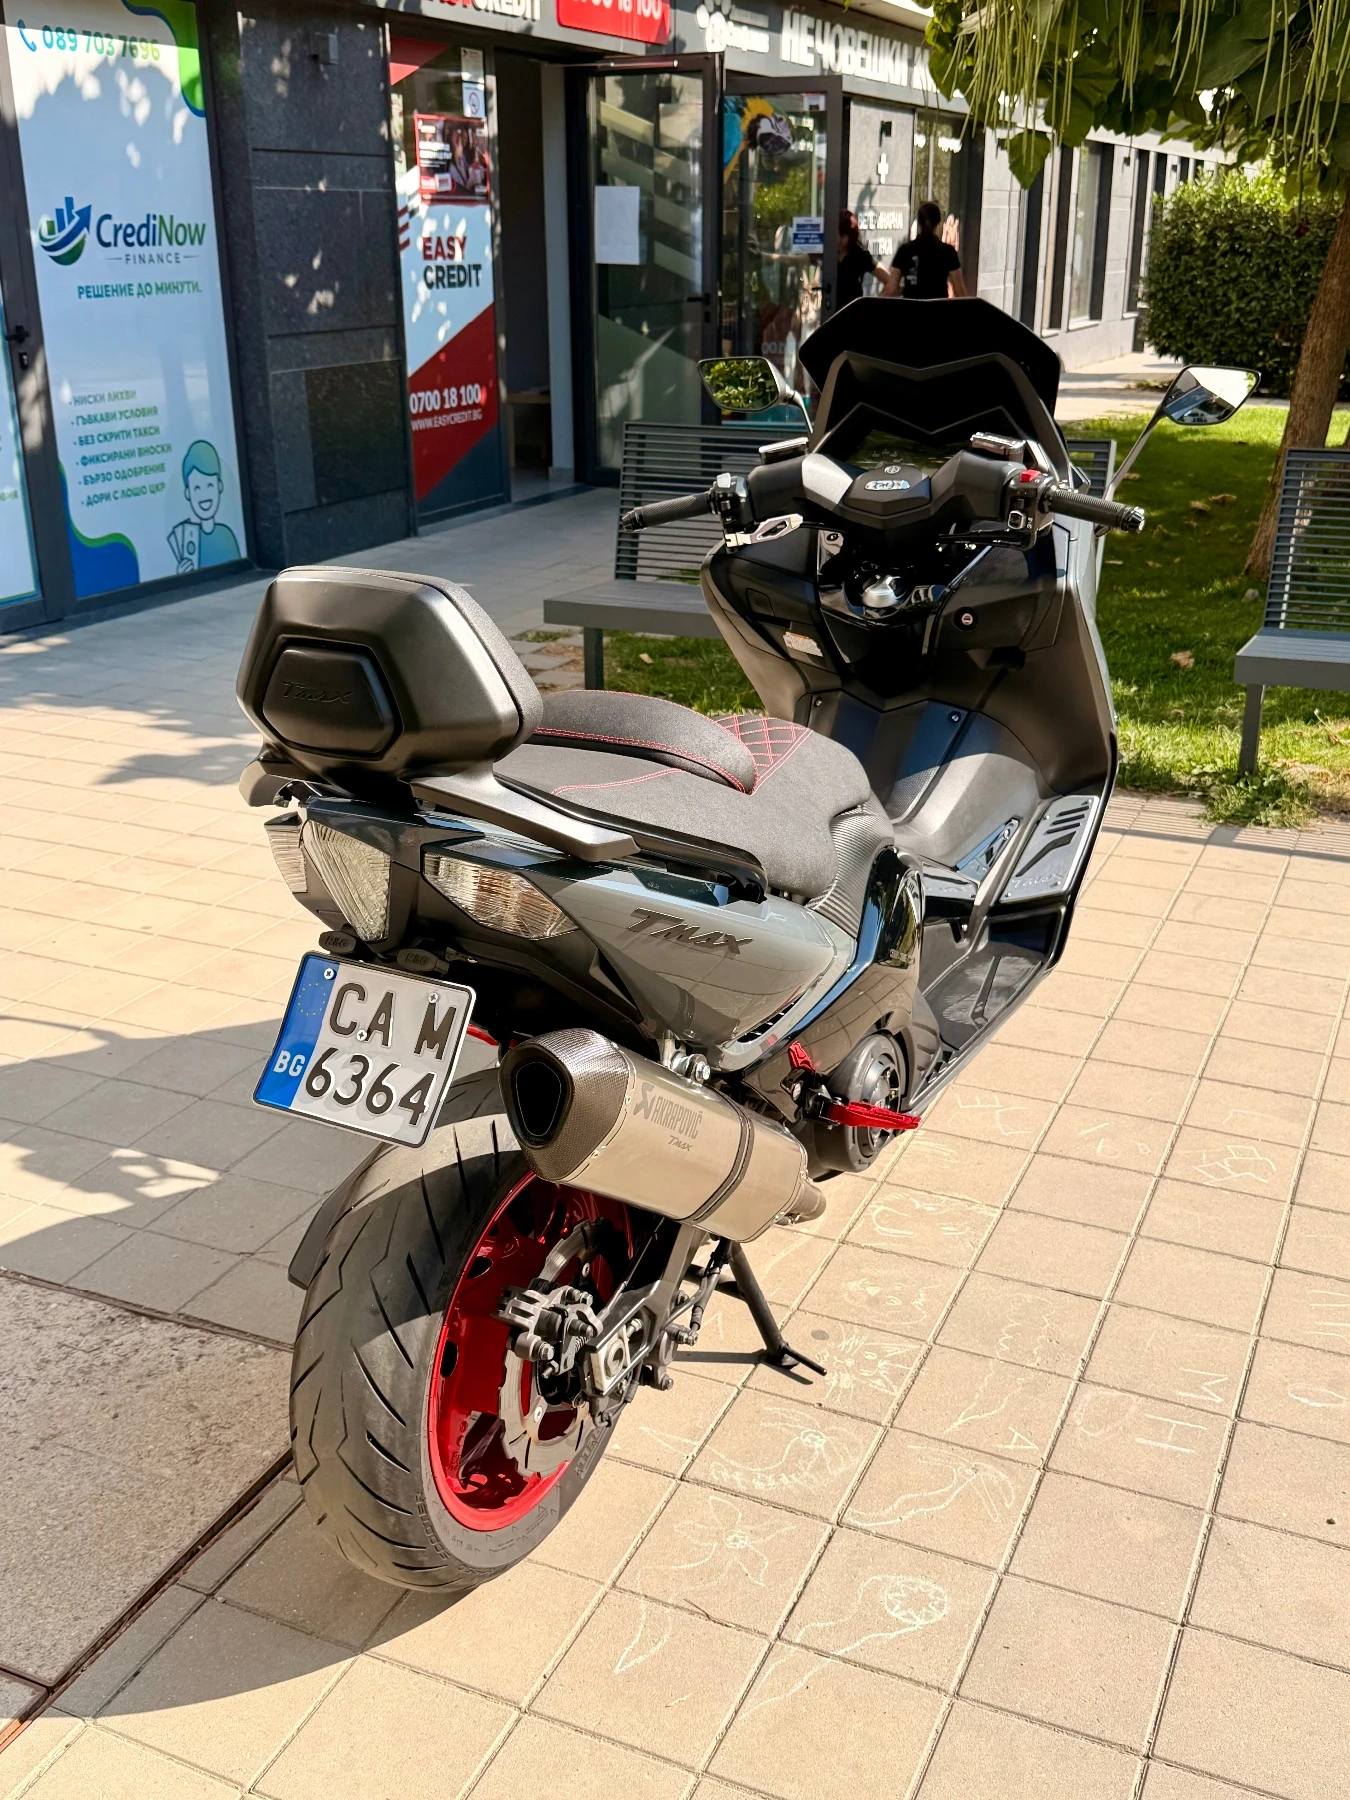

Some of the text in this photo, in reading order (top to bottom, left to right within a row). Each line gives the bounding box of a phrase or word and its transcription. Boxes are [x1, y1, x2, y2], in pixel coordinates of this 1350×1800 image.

[42, 25, 160, 60] 089 703 7696
[96, 213, 206, 248] CrediNow
[125, 252, 181, 265] FINANCE
[421, 236, 467, 261] EASY
[424, 263, 482, 289] CREDIT
[77, 283, 134, 299] РЕШЕНИЕ
[136, 282, 153, 298] ДО
[409, 383, 481, 414] 0700 18 100
[118, 406, 158, 420] УСЛОВИЯ
[78, 425, 160, 446] БЕЗ СКРИТИ ТАКСИ
[80, 443, 172, 466] ФИКСИРАНИ ВНОСКИ
[83, 463, 166, 486] БЪРЗО ОДОБРЕНИЕ
[86, 482, 166, 507] ДОРИ С ЛОШО ЦКР
[329, 982, 457, 1061] CA M
[273, 1050, 306, 1077] BG
[305, 1046, 438, 1127] 6364
